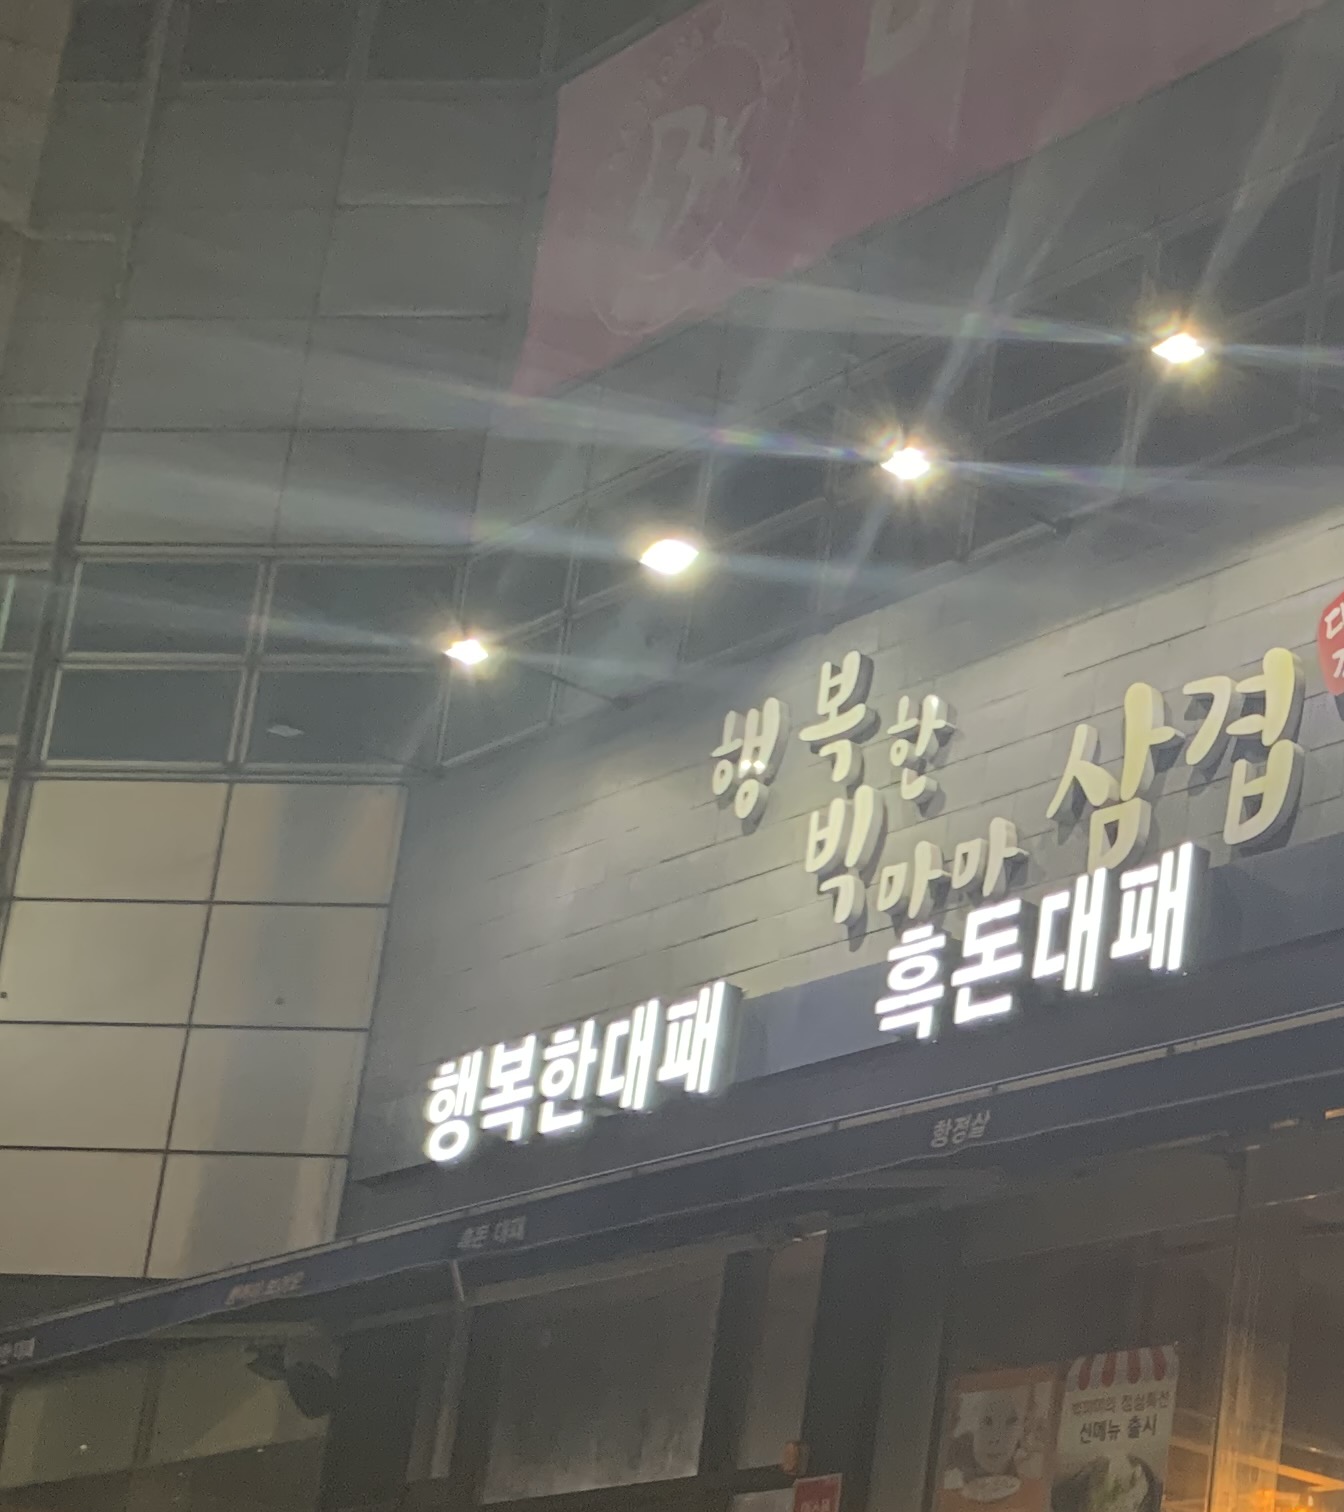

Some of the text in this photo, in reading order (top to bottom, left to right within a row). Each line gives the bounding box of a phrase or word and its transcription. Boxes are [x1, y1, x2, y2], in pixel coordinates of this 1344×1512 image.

[712, 646, 1303, 869] 행복한 삼겹
[804, 787, 1025, 924] 빅마마
[874, 842, 1194, 1039] 흑돈대패
[424, 980, 728, 1163] 행복한대패
[932, 1110, 990, 1148] 항정살
[1128, 1414, 1157, 1438] 출시
